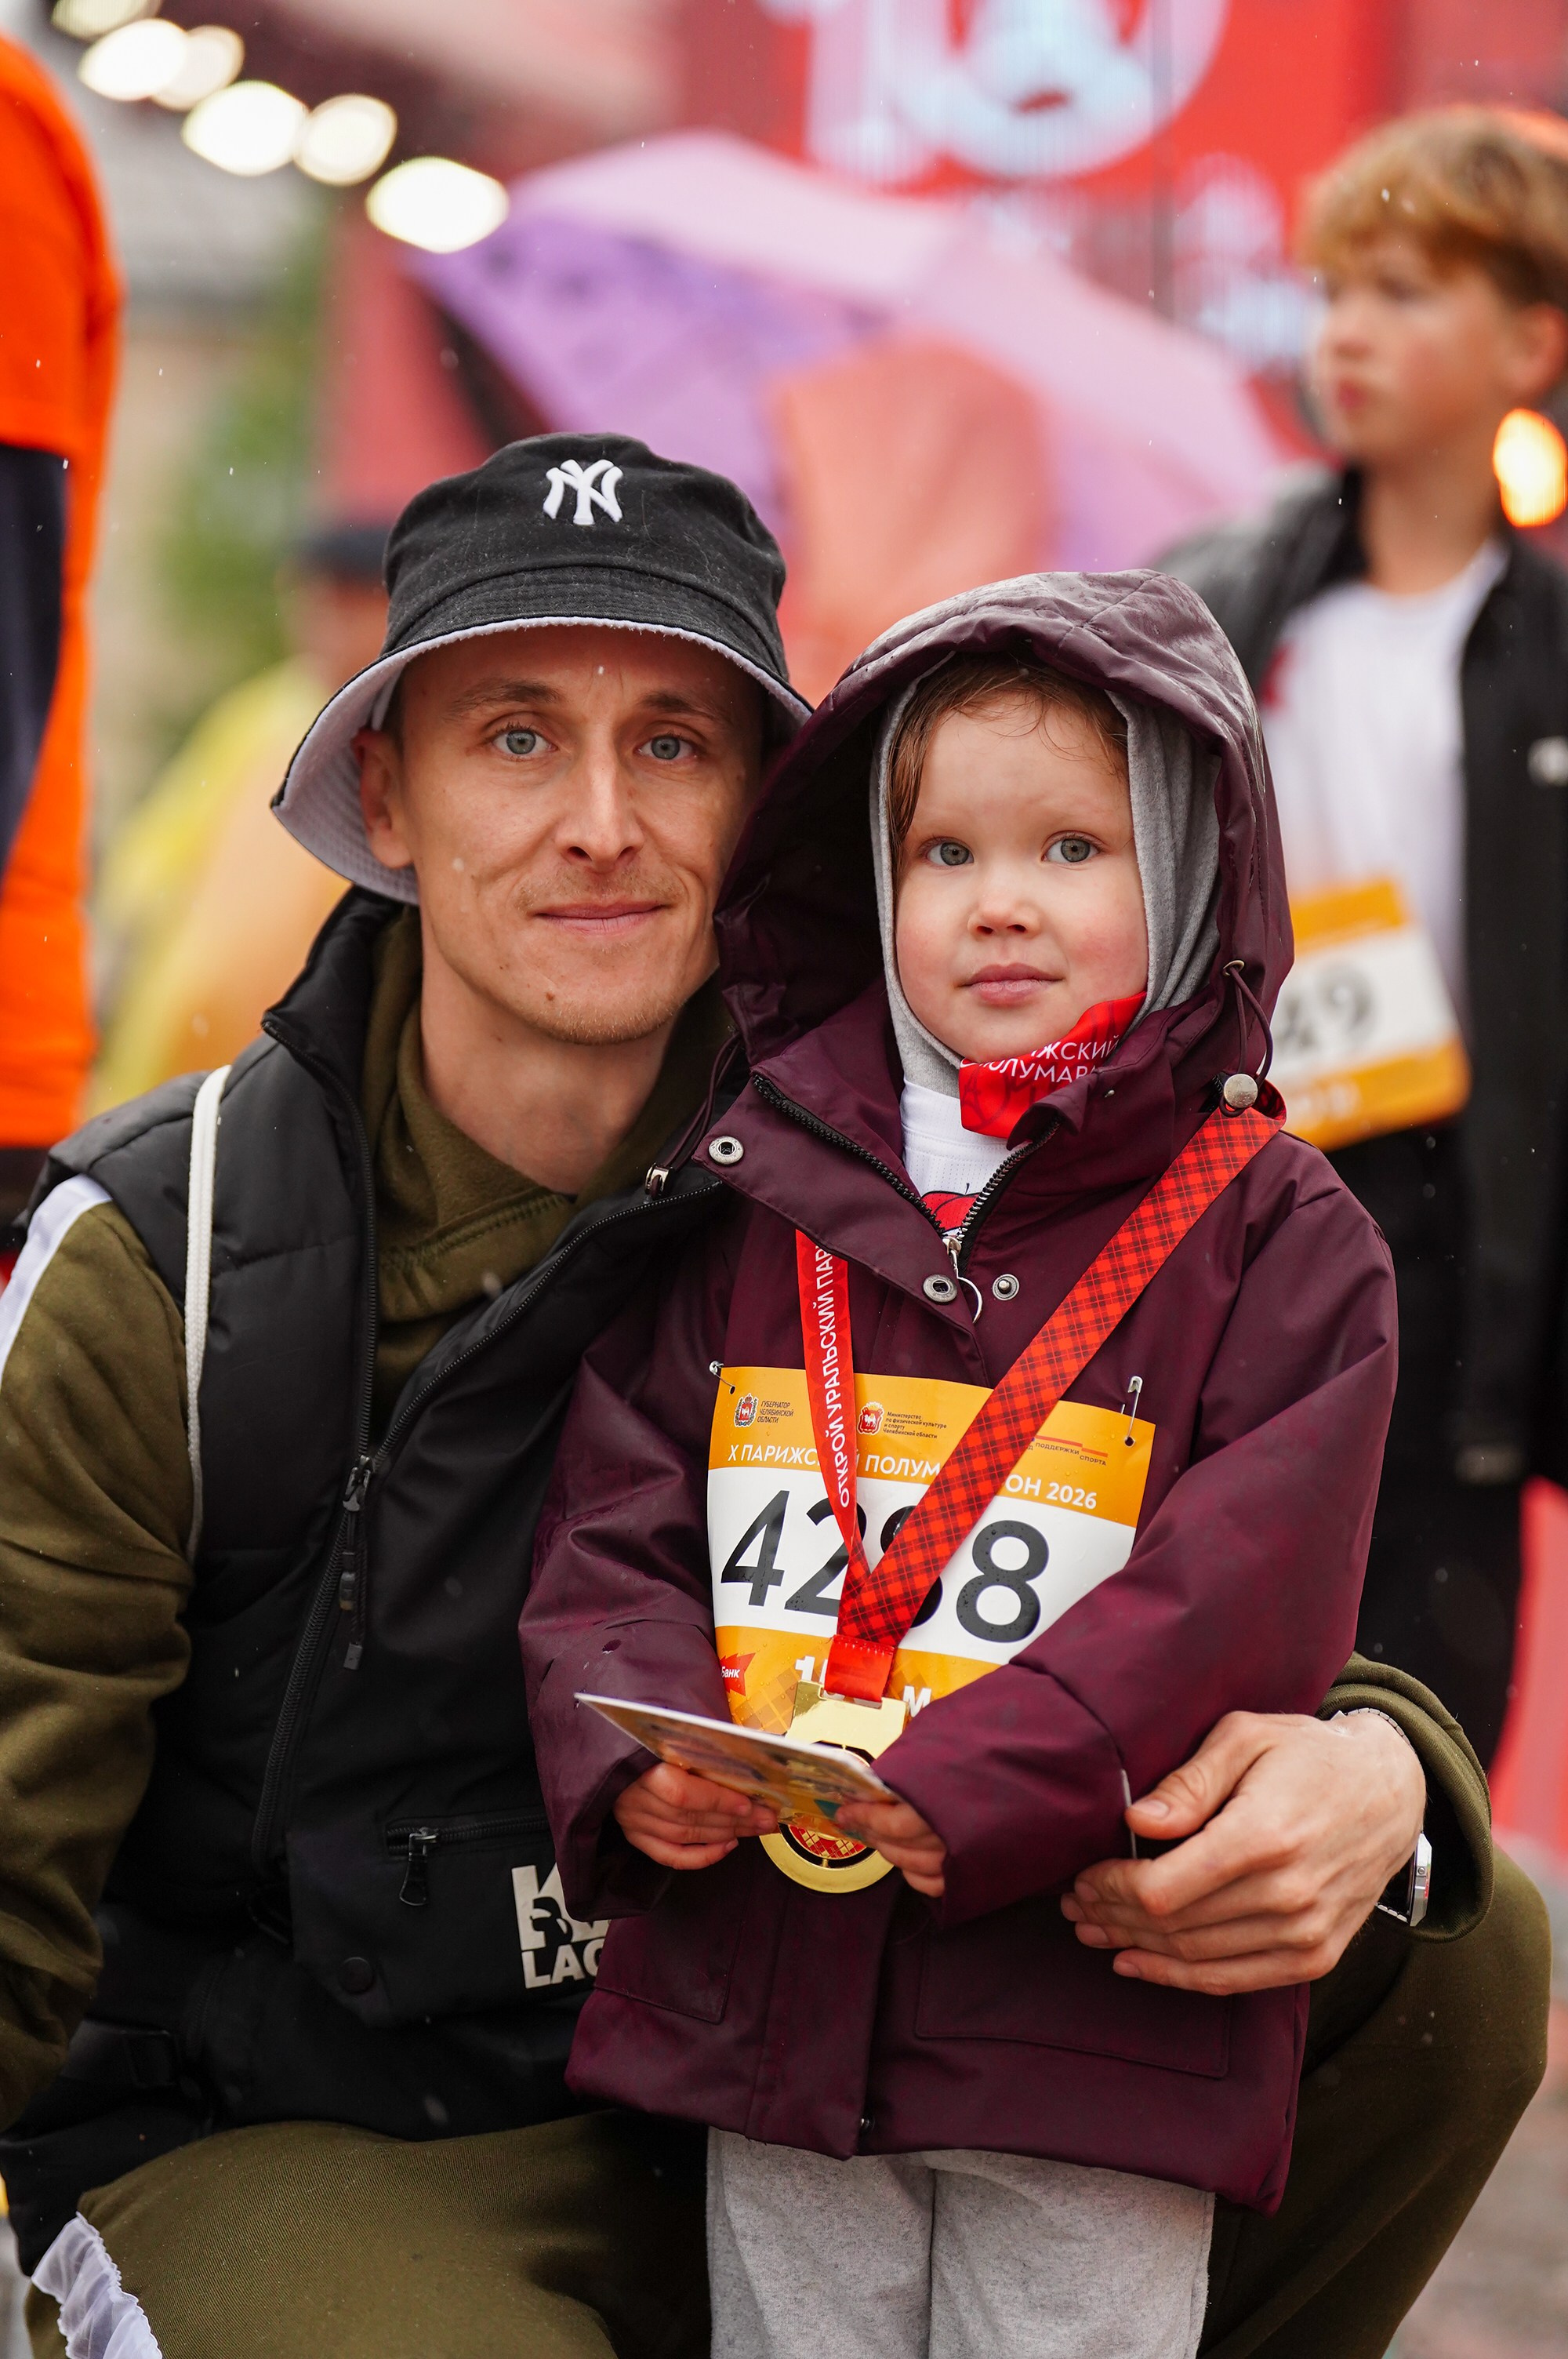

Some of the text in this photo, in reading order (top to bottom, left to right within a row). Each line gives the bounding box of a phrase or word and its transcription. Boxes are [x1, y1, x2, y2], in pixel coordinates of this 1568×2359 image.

[543, 459, 623, 525] NY
[1031, 1034, 1120, 1060] ЖСКИЙ
[813, 1245, 850, 1508] ОТКРОЙ УРАЛЬСКИЙ ПАР
[760, 1400, 791, 1408] ГУБЕРНАТОР
[759, 1408, 794, 1417] ЧЕЛЯБИНСКОЙ
[887, 1411, 922, 1420] Министерство
[757, 1415, 779, 1423] ОБЛАСТИ
[922, 1420, 947, 1429] культуре
[883, 1428, 916, 1438] Челябинской
[1035, 1442, 1080, 1456] ПОДДЕРЖКИ
[1080, 1455, 1107, 1467] СПОРТА
[1046, 1481, 1098, 1510] 2026
